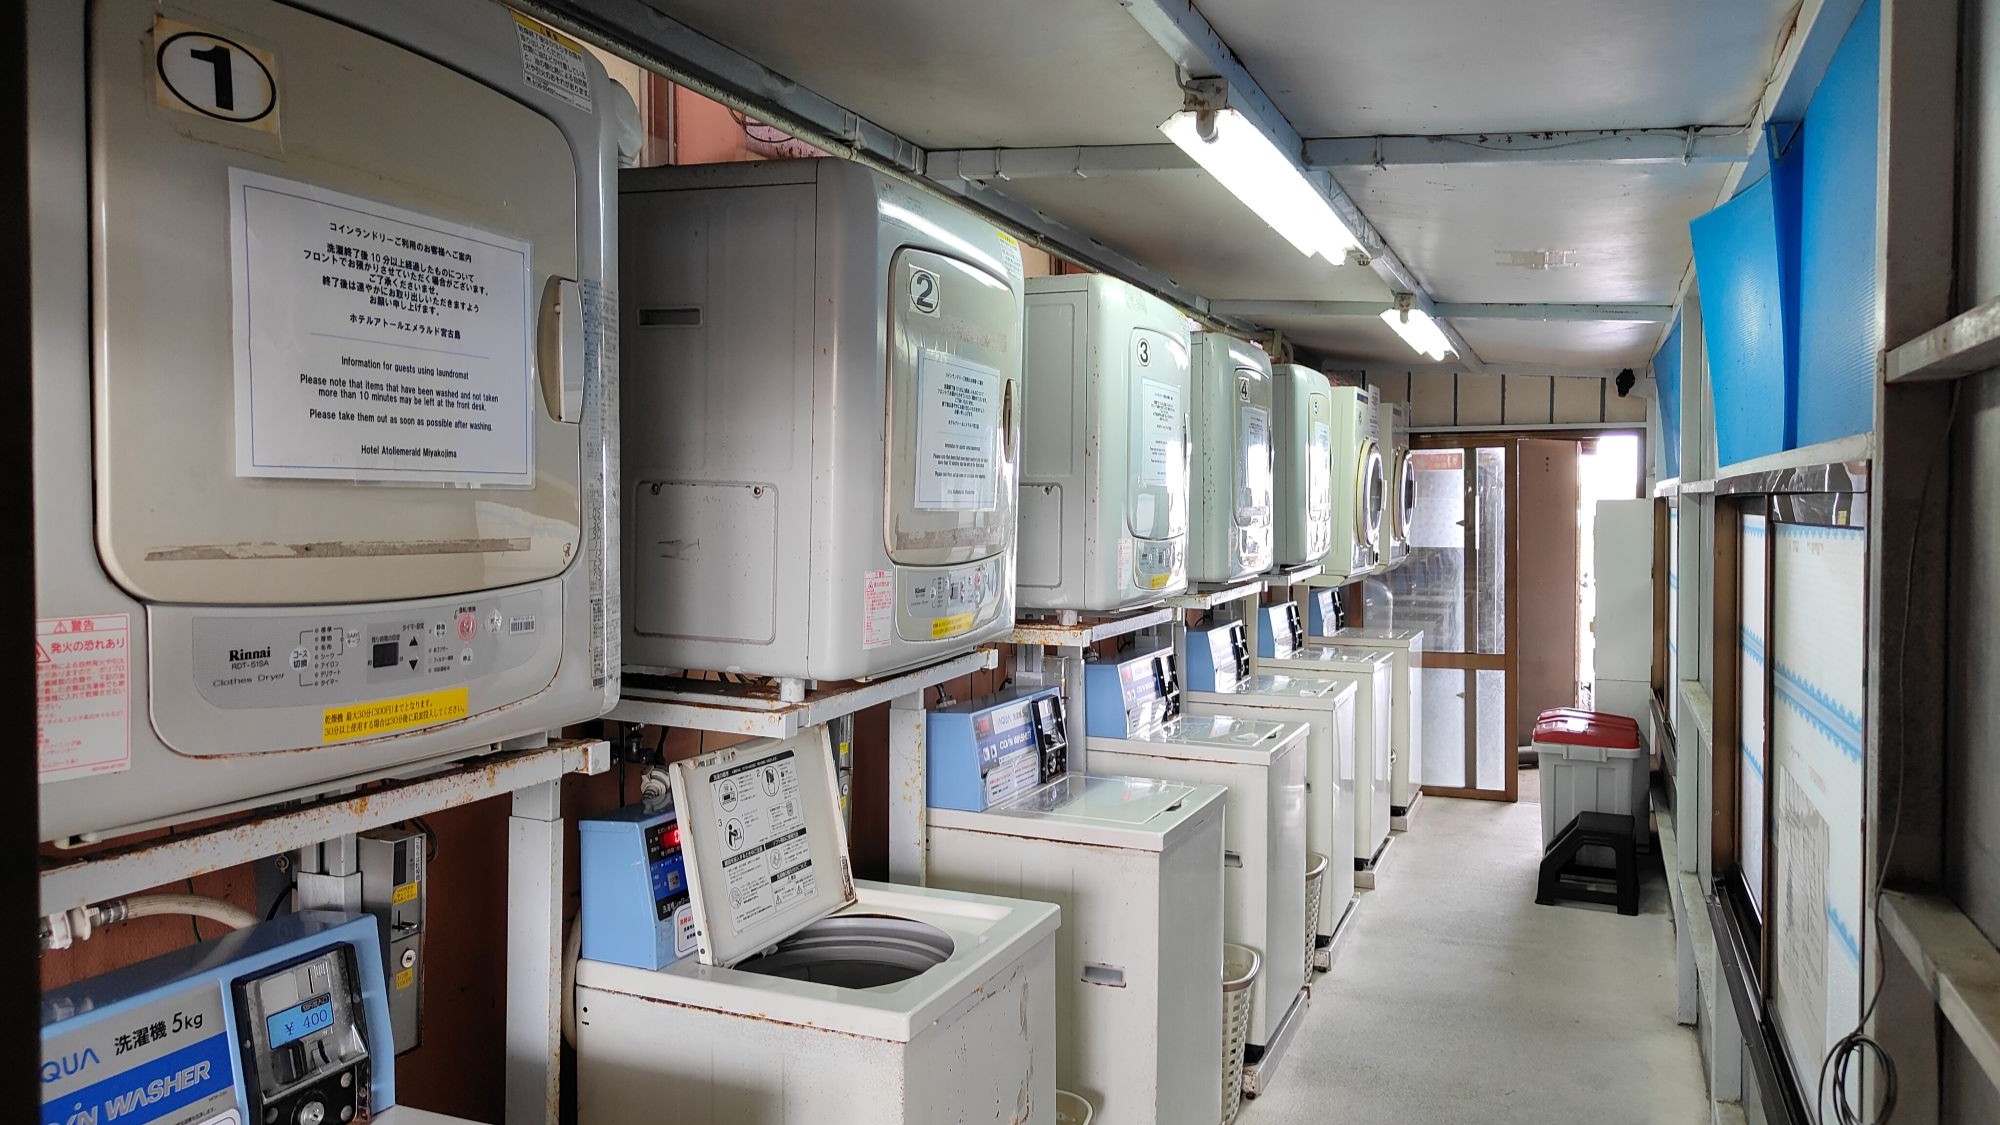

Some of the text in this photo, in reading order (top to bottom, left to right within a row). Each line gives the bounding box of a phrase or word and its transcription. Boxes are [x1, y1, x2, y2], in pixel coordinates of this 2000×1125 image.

[191, 46, 234, 110] 1
[329, 222, 472, 263] コインランドリーご利用のお客様へご案内
[371, 252, 381, 263] 10
[303, 249, 489, 296] フロントでお預かりさせていただく場合がございます。
[322, 275, 479, 313] 終了後は速やかにお取り出しいただきますよう
[369, 273, 439, 296] ご了承くださいませ。
[916, 274, 934, 309] 2
[370, 295, 440, 316] お願い申し上げます。
[350, 313, 461, 340] ホテルアトールエメラルド宮古島
[1139, 341, 1148, 363] 3
[341, 356, 469, 380] Information for guests using laundromat
[300, 373, 499, 403] Please note that items that have been washed and not taken
[318, 388, 487, 411] more than 10 minutes may be left at the front desk.
[1240, 381, 1248, 398] 4
[309, 409, 493, 432] Please take them out as soon as possible after washing.
[361, 445, 380, 455] Hotel
[422, 447, 457, 459] Miyakojima
[71, 620, 95, 632] 警告
[51, 637, 125, 654] 発火の恐れあり
[229, 646, 271, 662] Rinnai
[231, 660, 270, 671] RDT-51SA
[212, 672, 286, 687] Clothes Dryer
[320, 678, 339, 687] タイマー
[114, 1019, 168, 1056] 洗濯機
[171, 1011, 203, 1034] 5kg
[284, 1009, 329, 1036] ¥ 400
[105, 1060, 211, 1121] WASHER
